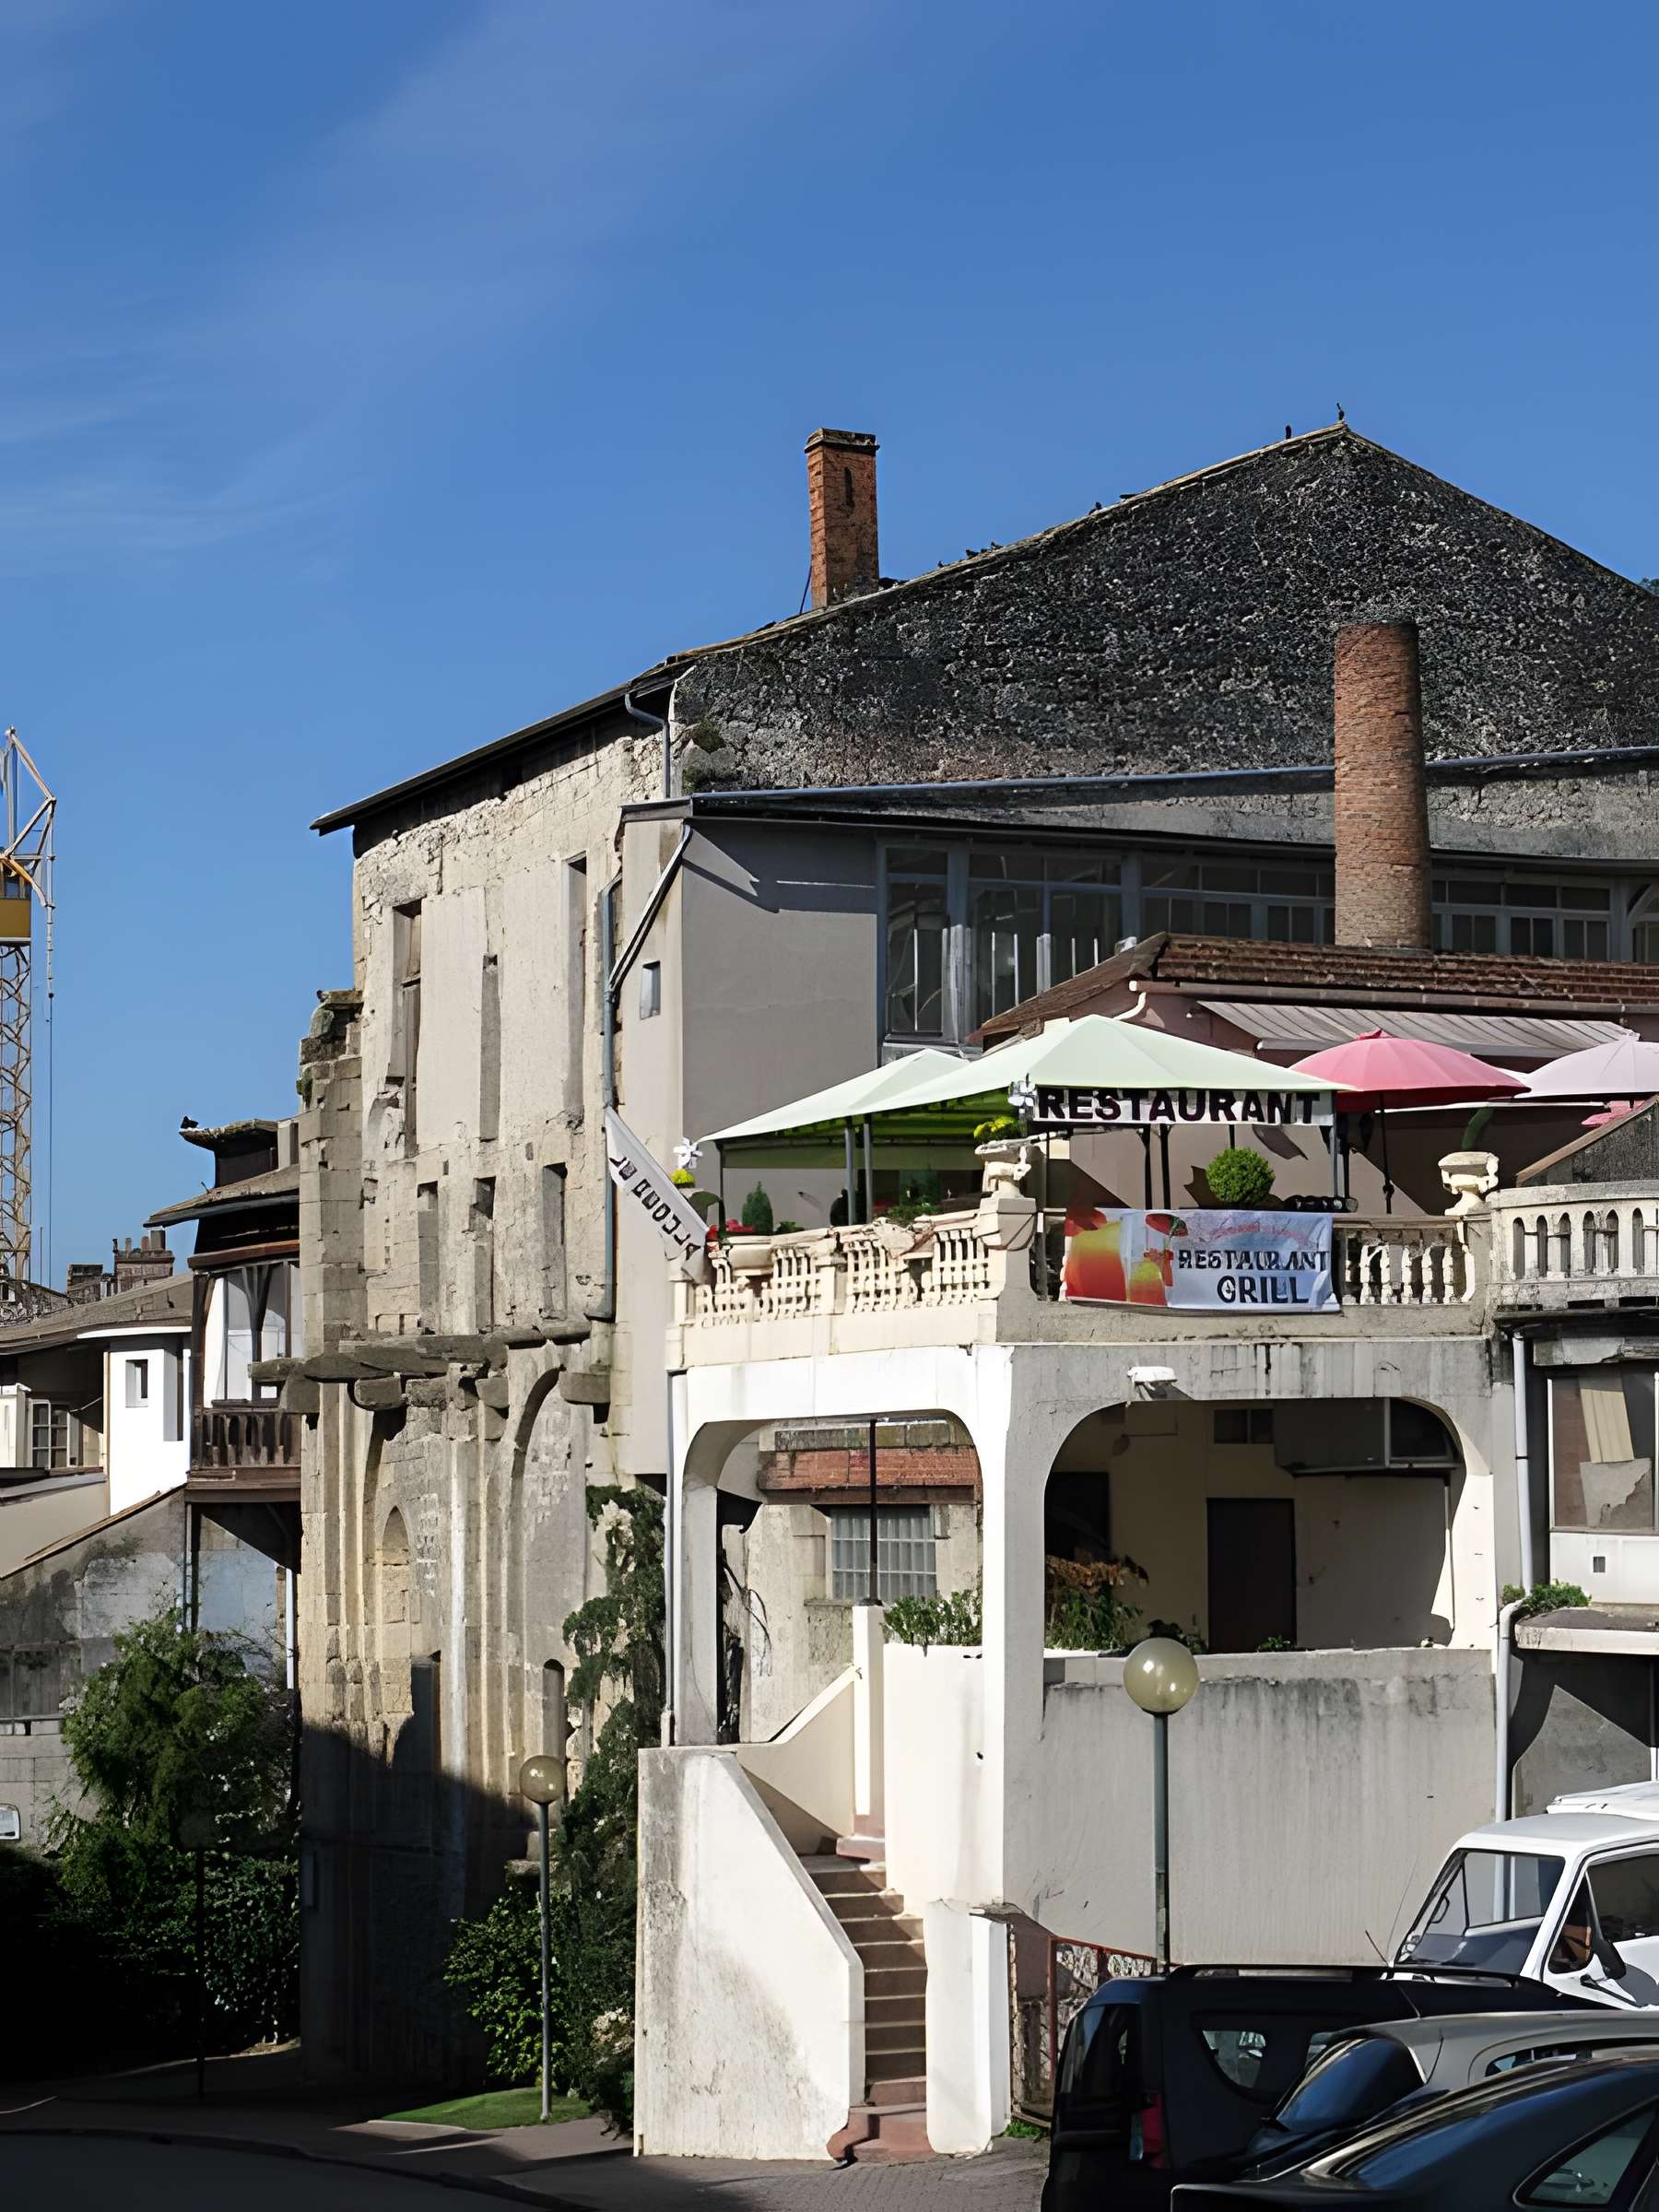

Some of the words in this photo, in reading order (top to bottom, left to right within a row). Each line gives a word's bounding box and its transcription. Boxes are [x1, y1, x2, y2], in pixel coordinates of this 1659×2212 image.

[1038, 1088, 1321, 1124] RESTAURANT
[1178, 1249, 1329, 1272] RESTAURANT
[1217, 1275, 1310, 1304] GRILL
